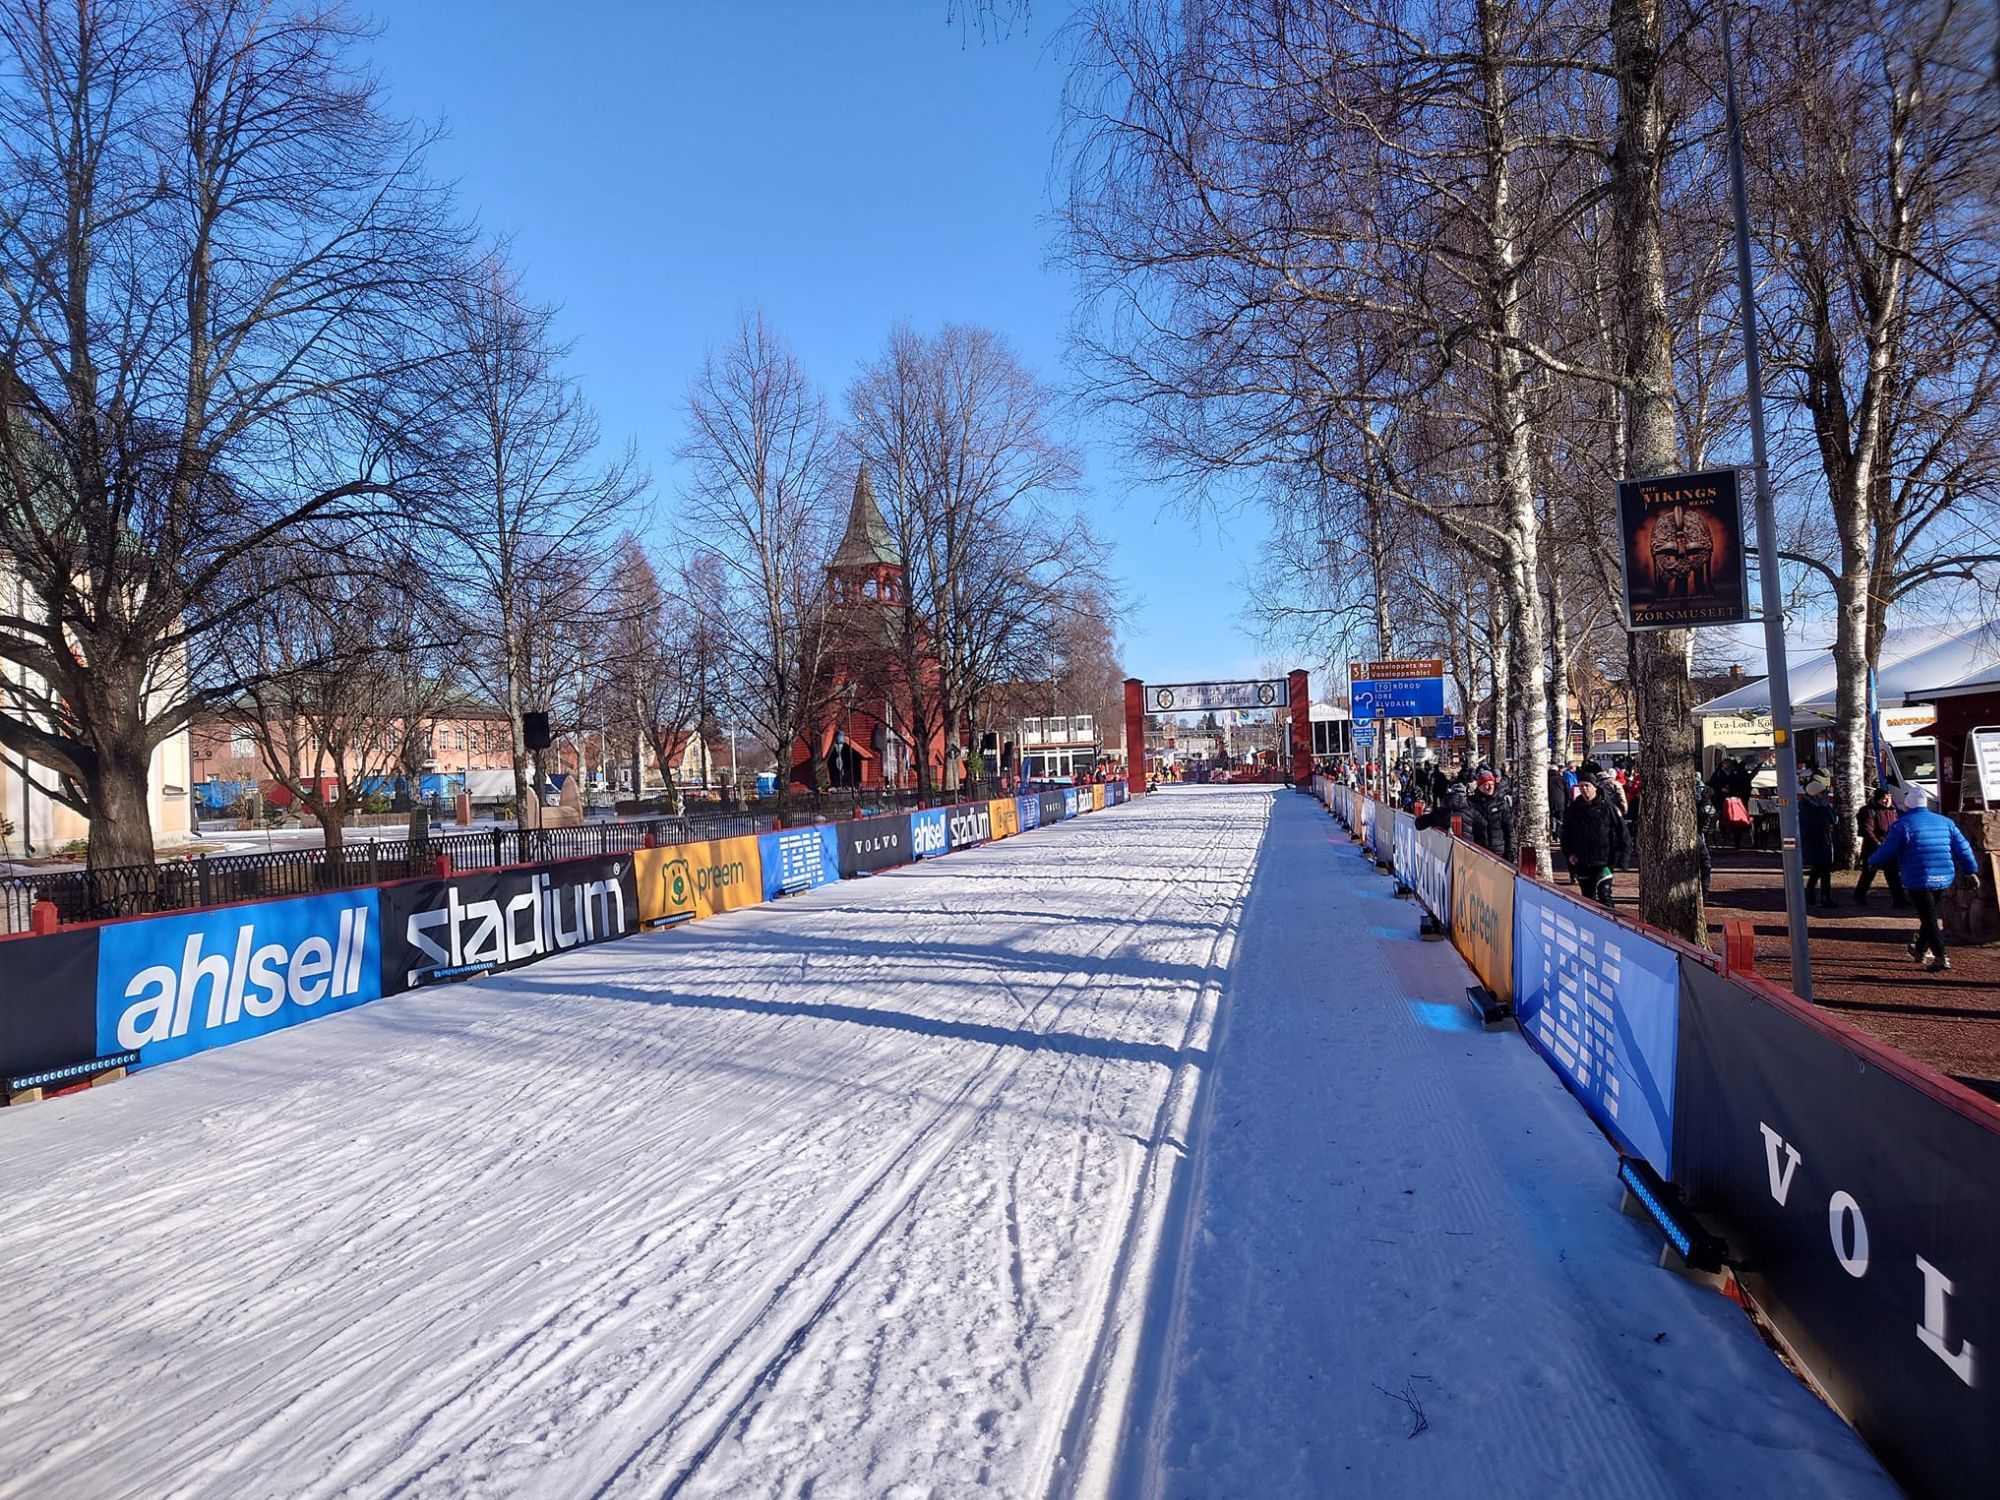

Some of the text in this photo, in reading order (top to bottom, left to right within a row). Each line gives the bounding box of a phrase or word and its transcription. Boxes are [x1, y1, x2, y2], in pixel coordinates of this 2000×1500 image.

[1643, 487, 1717, 503] VIKINGS
[1635, 606, 1736, 622] ZORNMUSEET
[1371, 670, 1430, 678] Vasaloppsmålet
[1713, 720, 1755, 730] Eva-Lotts
[855, 833, 898, 855] VOLVO
[914, 814, 946, 854] ahlsell
[950, 805, 990, 848] stadium
[697, 861, 744, 898] preem
[779, 831, 824, 889] IBM
[405, 873, 625, 988] stadium
[1469, 889, 1499, 951] preem
[117, 906, 368, 1050] ahlsell
[1540, 905, 1621, 1119] IBM
